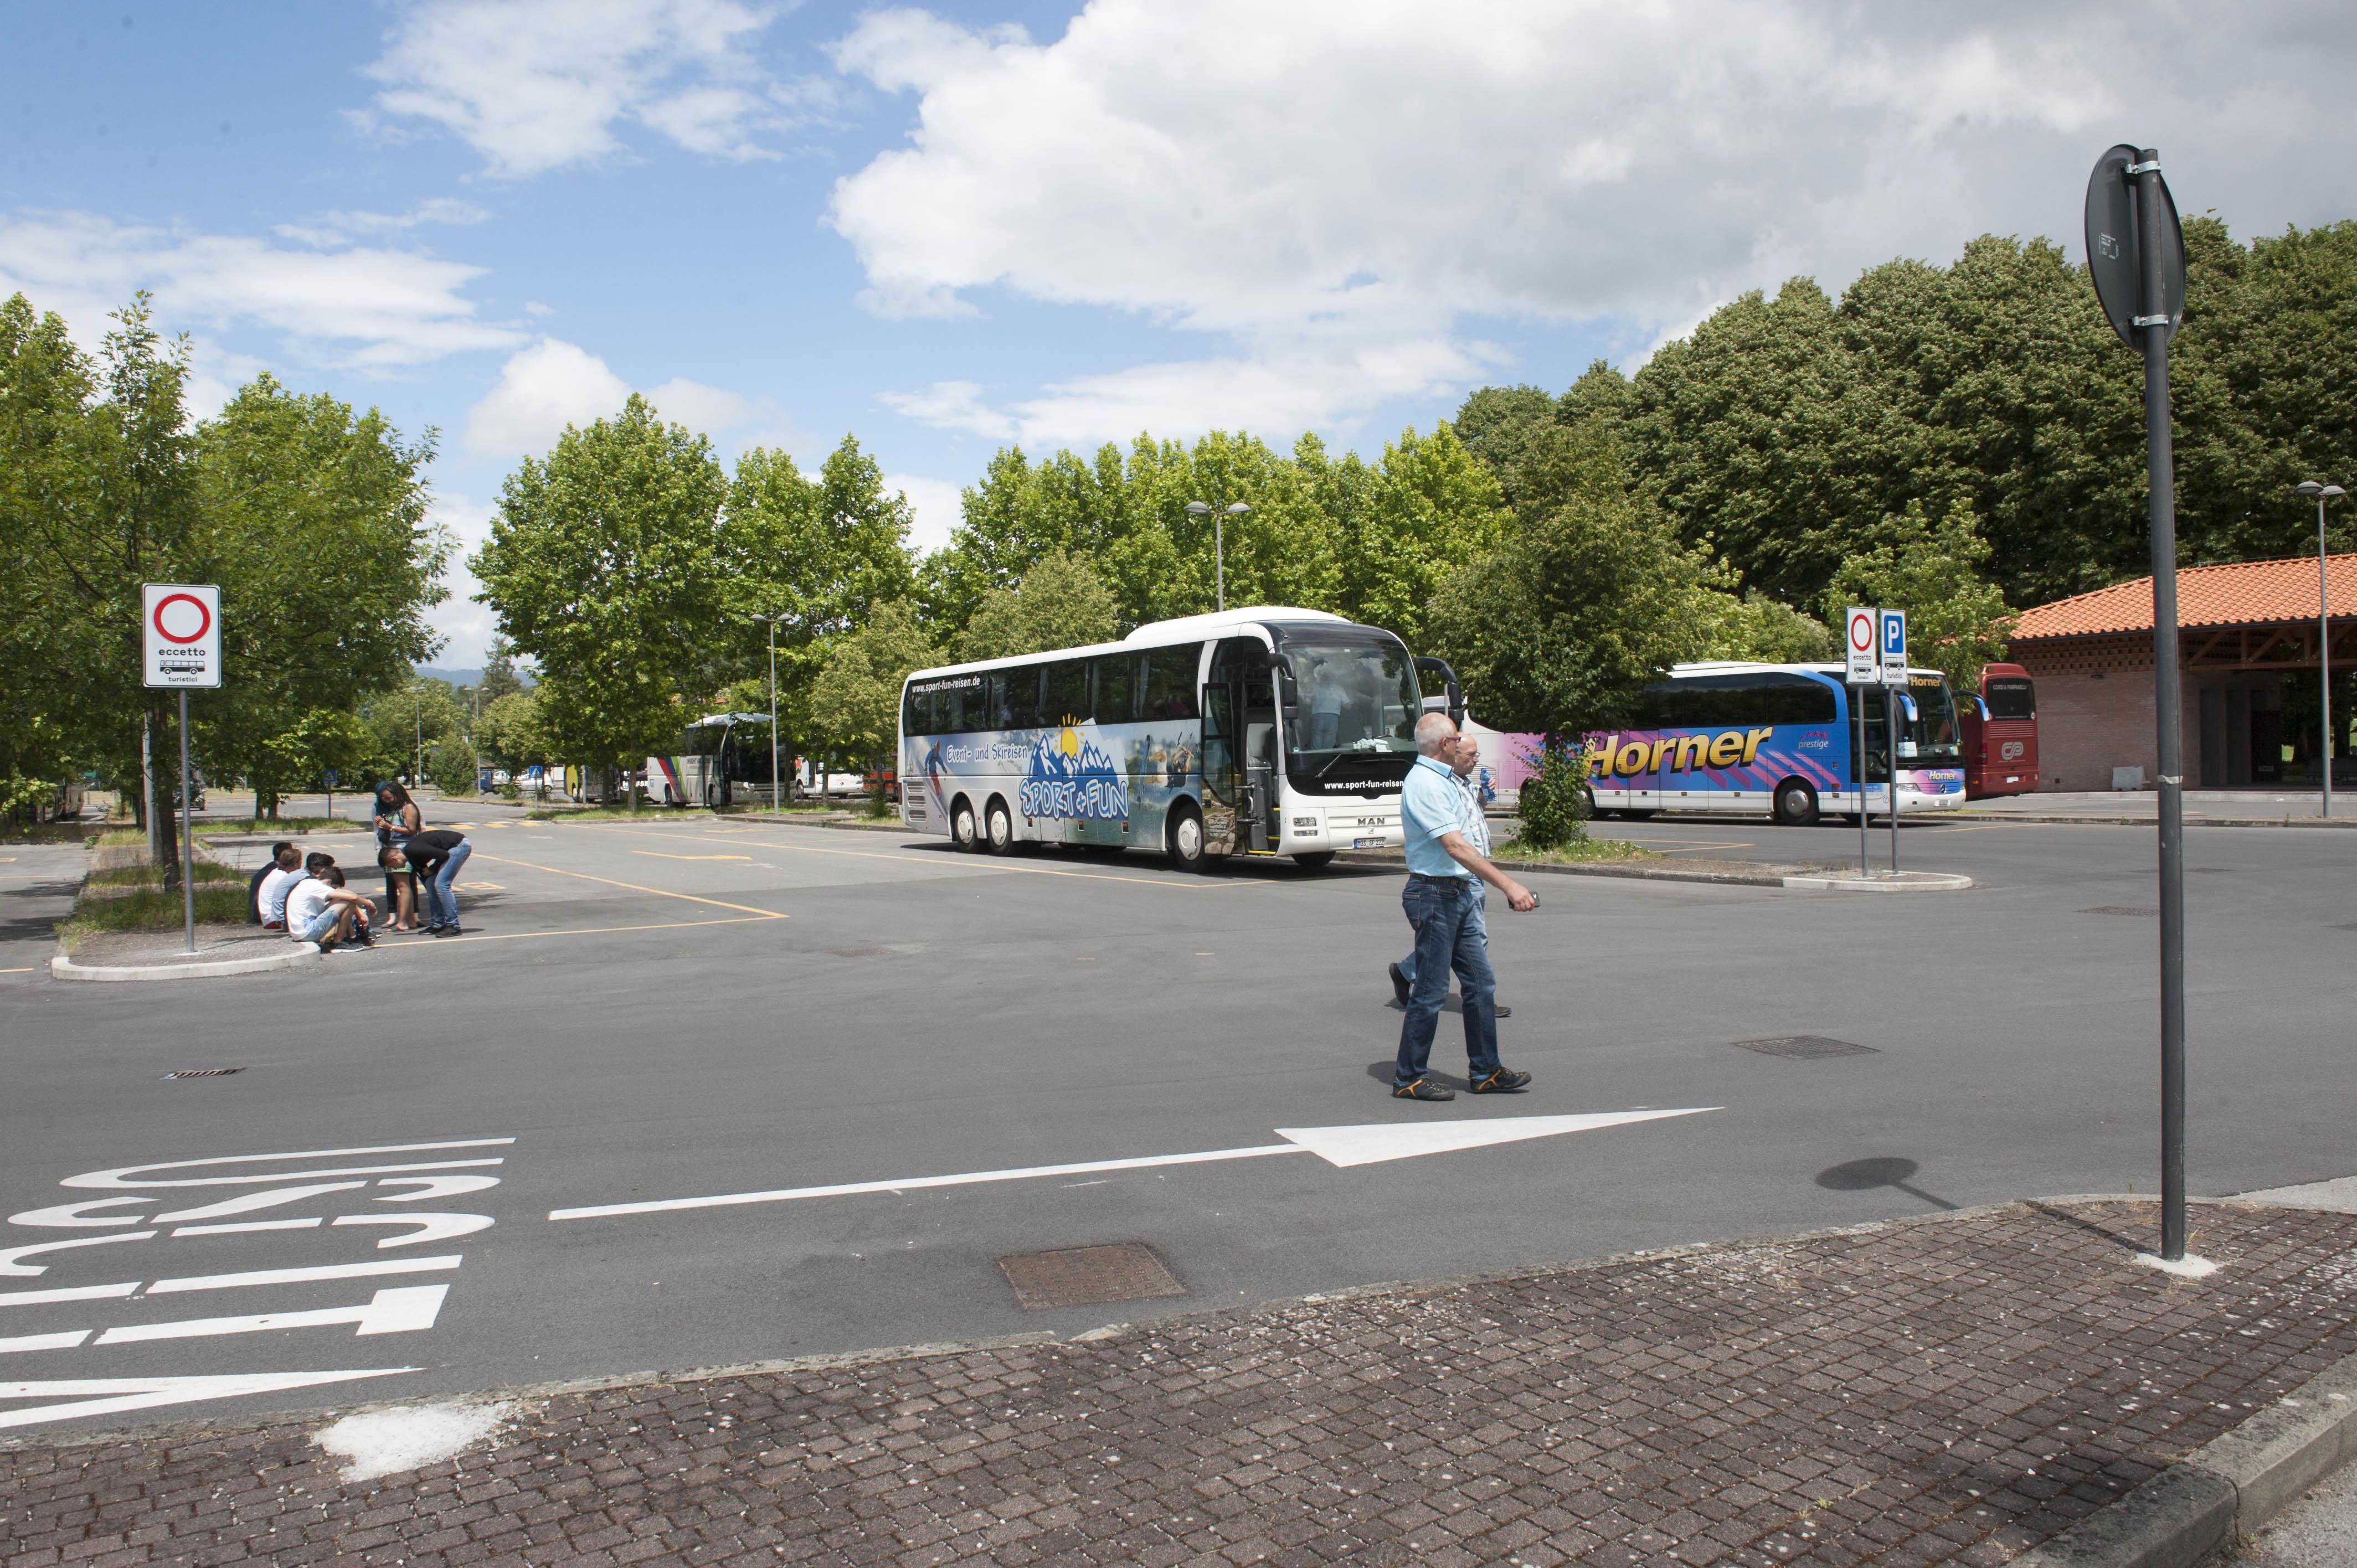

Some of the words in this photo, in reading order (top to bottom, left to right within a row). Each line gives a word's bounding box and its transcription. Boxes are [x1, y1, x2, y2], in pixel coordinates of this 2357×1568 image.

[1888, 620, 1899, 648] P
[158, 648, 206, 656] eccetto
[912, 675, 980, 693] www.sport-fun-reisen.de
[1910, 677, 1941, 687] Horner
[1798, 739, 1829, 750] prestige
[946, 744, 972, 762] Event-
[975, 744, 989, 760] und
[991, 743, 1028, 760] Skireisen
[1584, 726, 1774, 777] Horner
[1928, 770, 1956, 781] Horner
[1357, 817, 1386, 826] MAN
